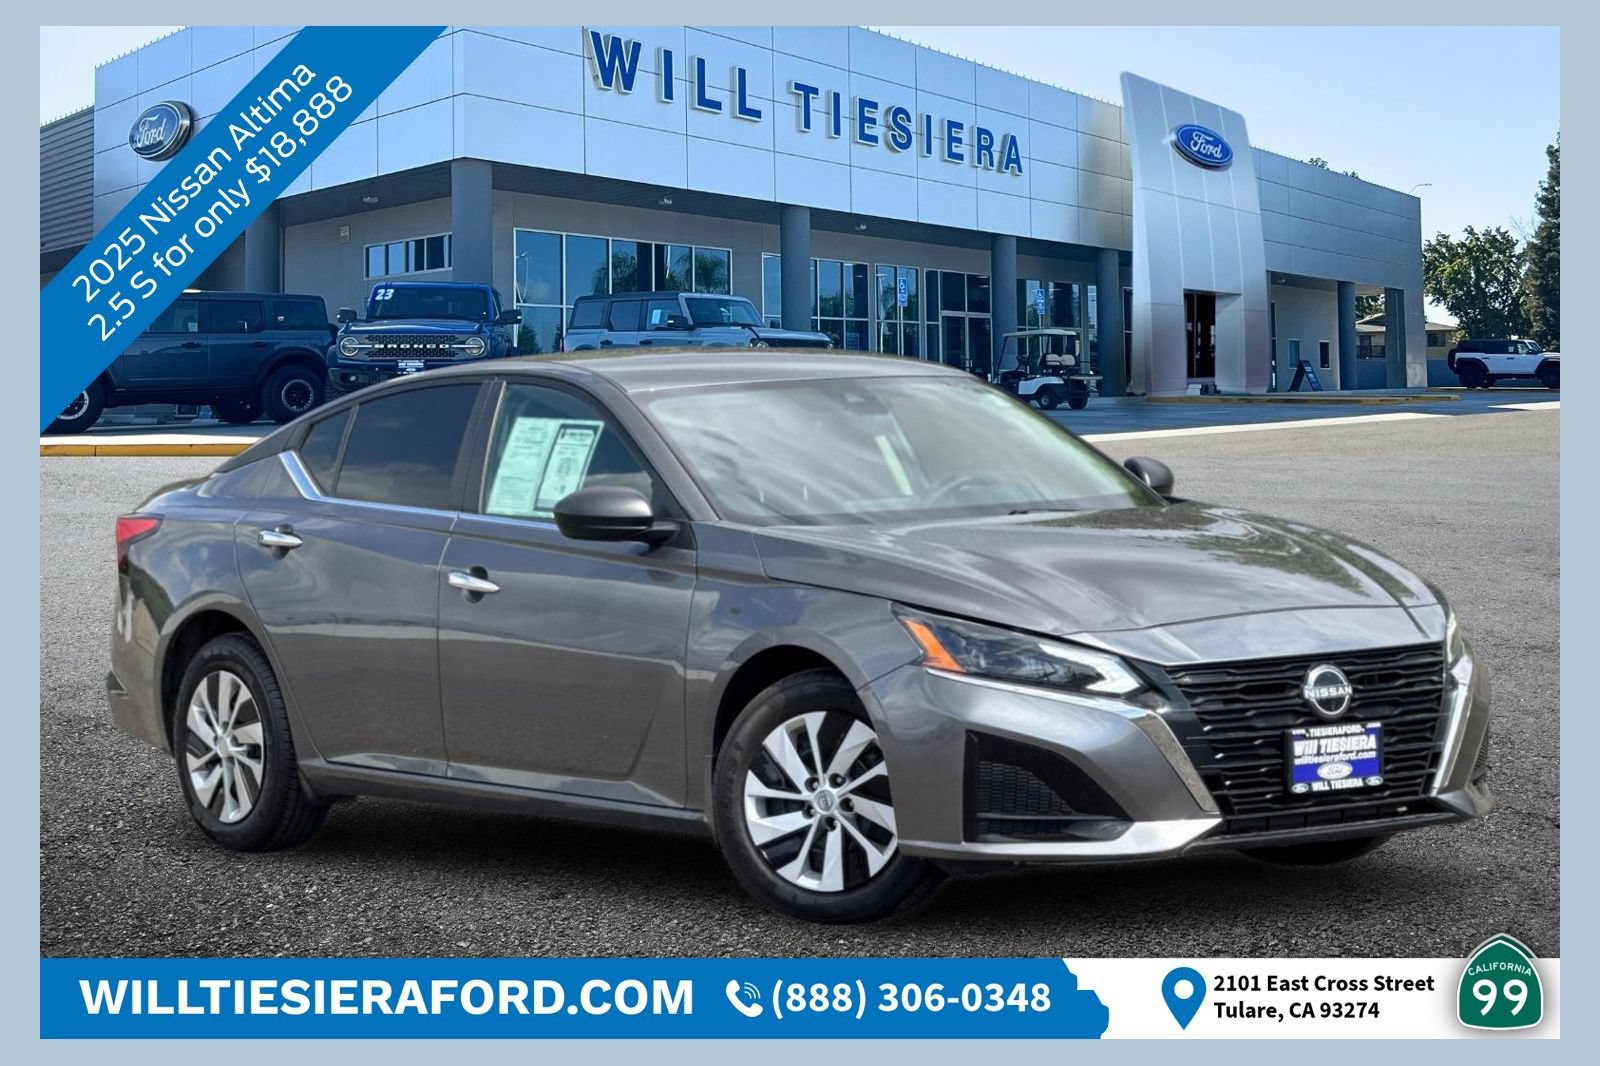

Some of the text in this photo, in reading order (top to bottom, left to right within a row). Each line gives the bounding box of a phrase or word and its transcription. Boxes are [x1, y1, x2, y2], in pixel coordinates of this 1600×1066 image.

[588, 29, 1024, 175] WILL TIESIERA
[136, 114, 167, 149] Ford
[1190, 131, 1223, 159] Ford
[374, 288, 395, 301] 23
[1304, 685, 1353, 700] NISSAN
[1319, 733, 1377, 754] TIESIERA
[1311, 780, 1331, 792] WILL
